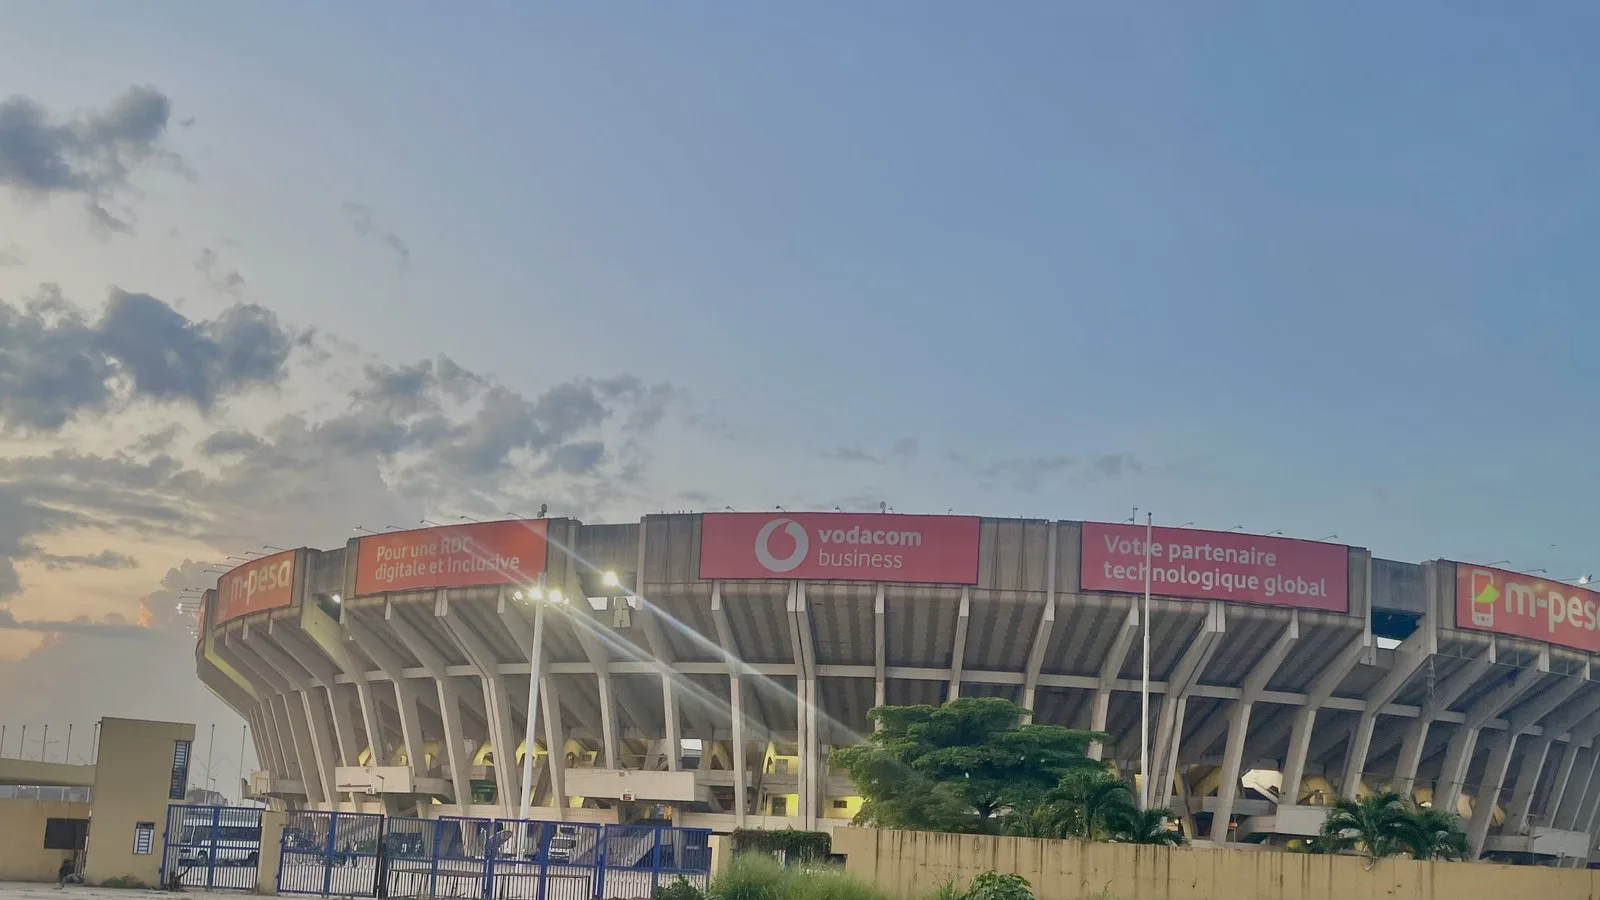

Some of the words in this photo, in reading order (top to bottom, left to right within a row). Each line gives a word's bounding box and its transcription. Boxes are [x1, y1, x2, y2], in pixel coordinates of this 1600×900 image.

[377, 545, 408, 562] Pour
[411, 542, 437, 558] une
[441, 536, 473, 554] RDC
[818, 526, 921, 546] vodacom
[1104, 534, 1162, 557] Votre
[1169, 541, 1277, 567] partenaire
[375, 560, 426, 583] digitale
[429, 559, 443, 574] et
[819, 549, 902, 568] business
[230, 560, 291, 606] m-pesa
[1104, 561, 1259, 592] technologique
[1264, 576, 1326, 597] global
[1505, 582, 1600, 633] m-pes
